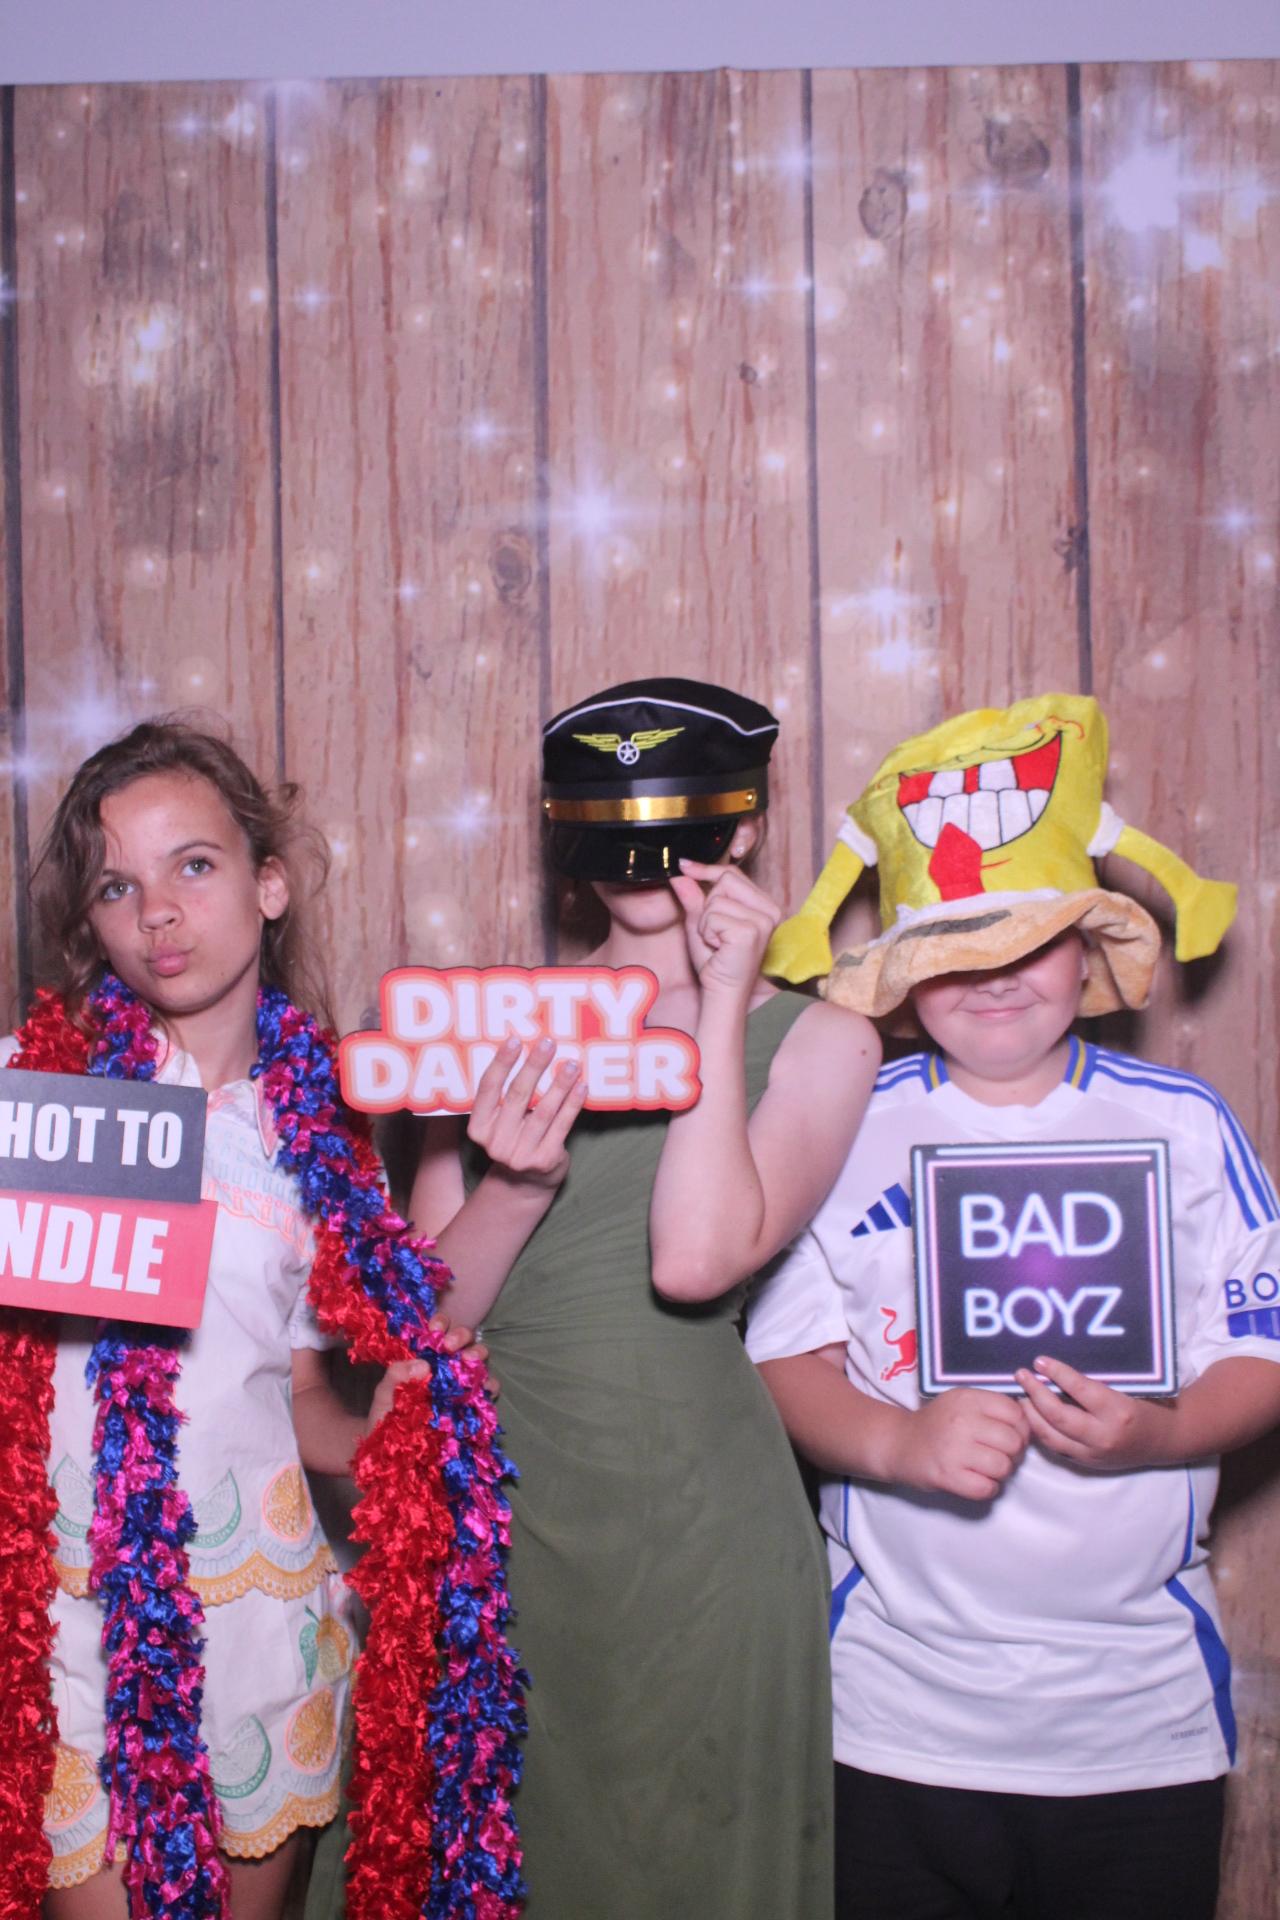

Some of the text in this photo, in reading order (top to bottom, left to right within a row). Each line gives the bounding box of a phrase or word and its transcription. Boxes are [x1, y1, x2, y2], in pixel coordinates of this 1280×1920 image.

[394, 981, 646, 1040] DIRTY
[0, 1101, 183, 1169] HOT TO
[0, 1199, 169, 1296] NDLE
[959, 1192, 1124, 1259] BAD
[963, 1286, 1126, 1338] BOYZ
[1225, 1270, 1280, 1309] BO
